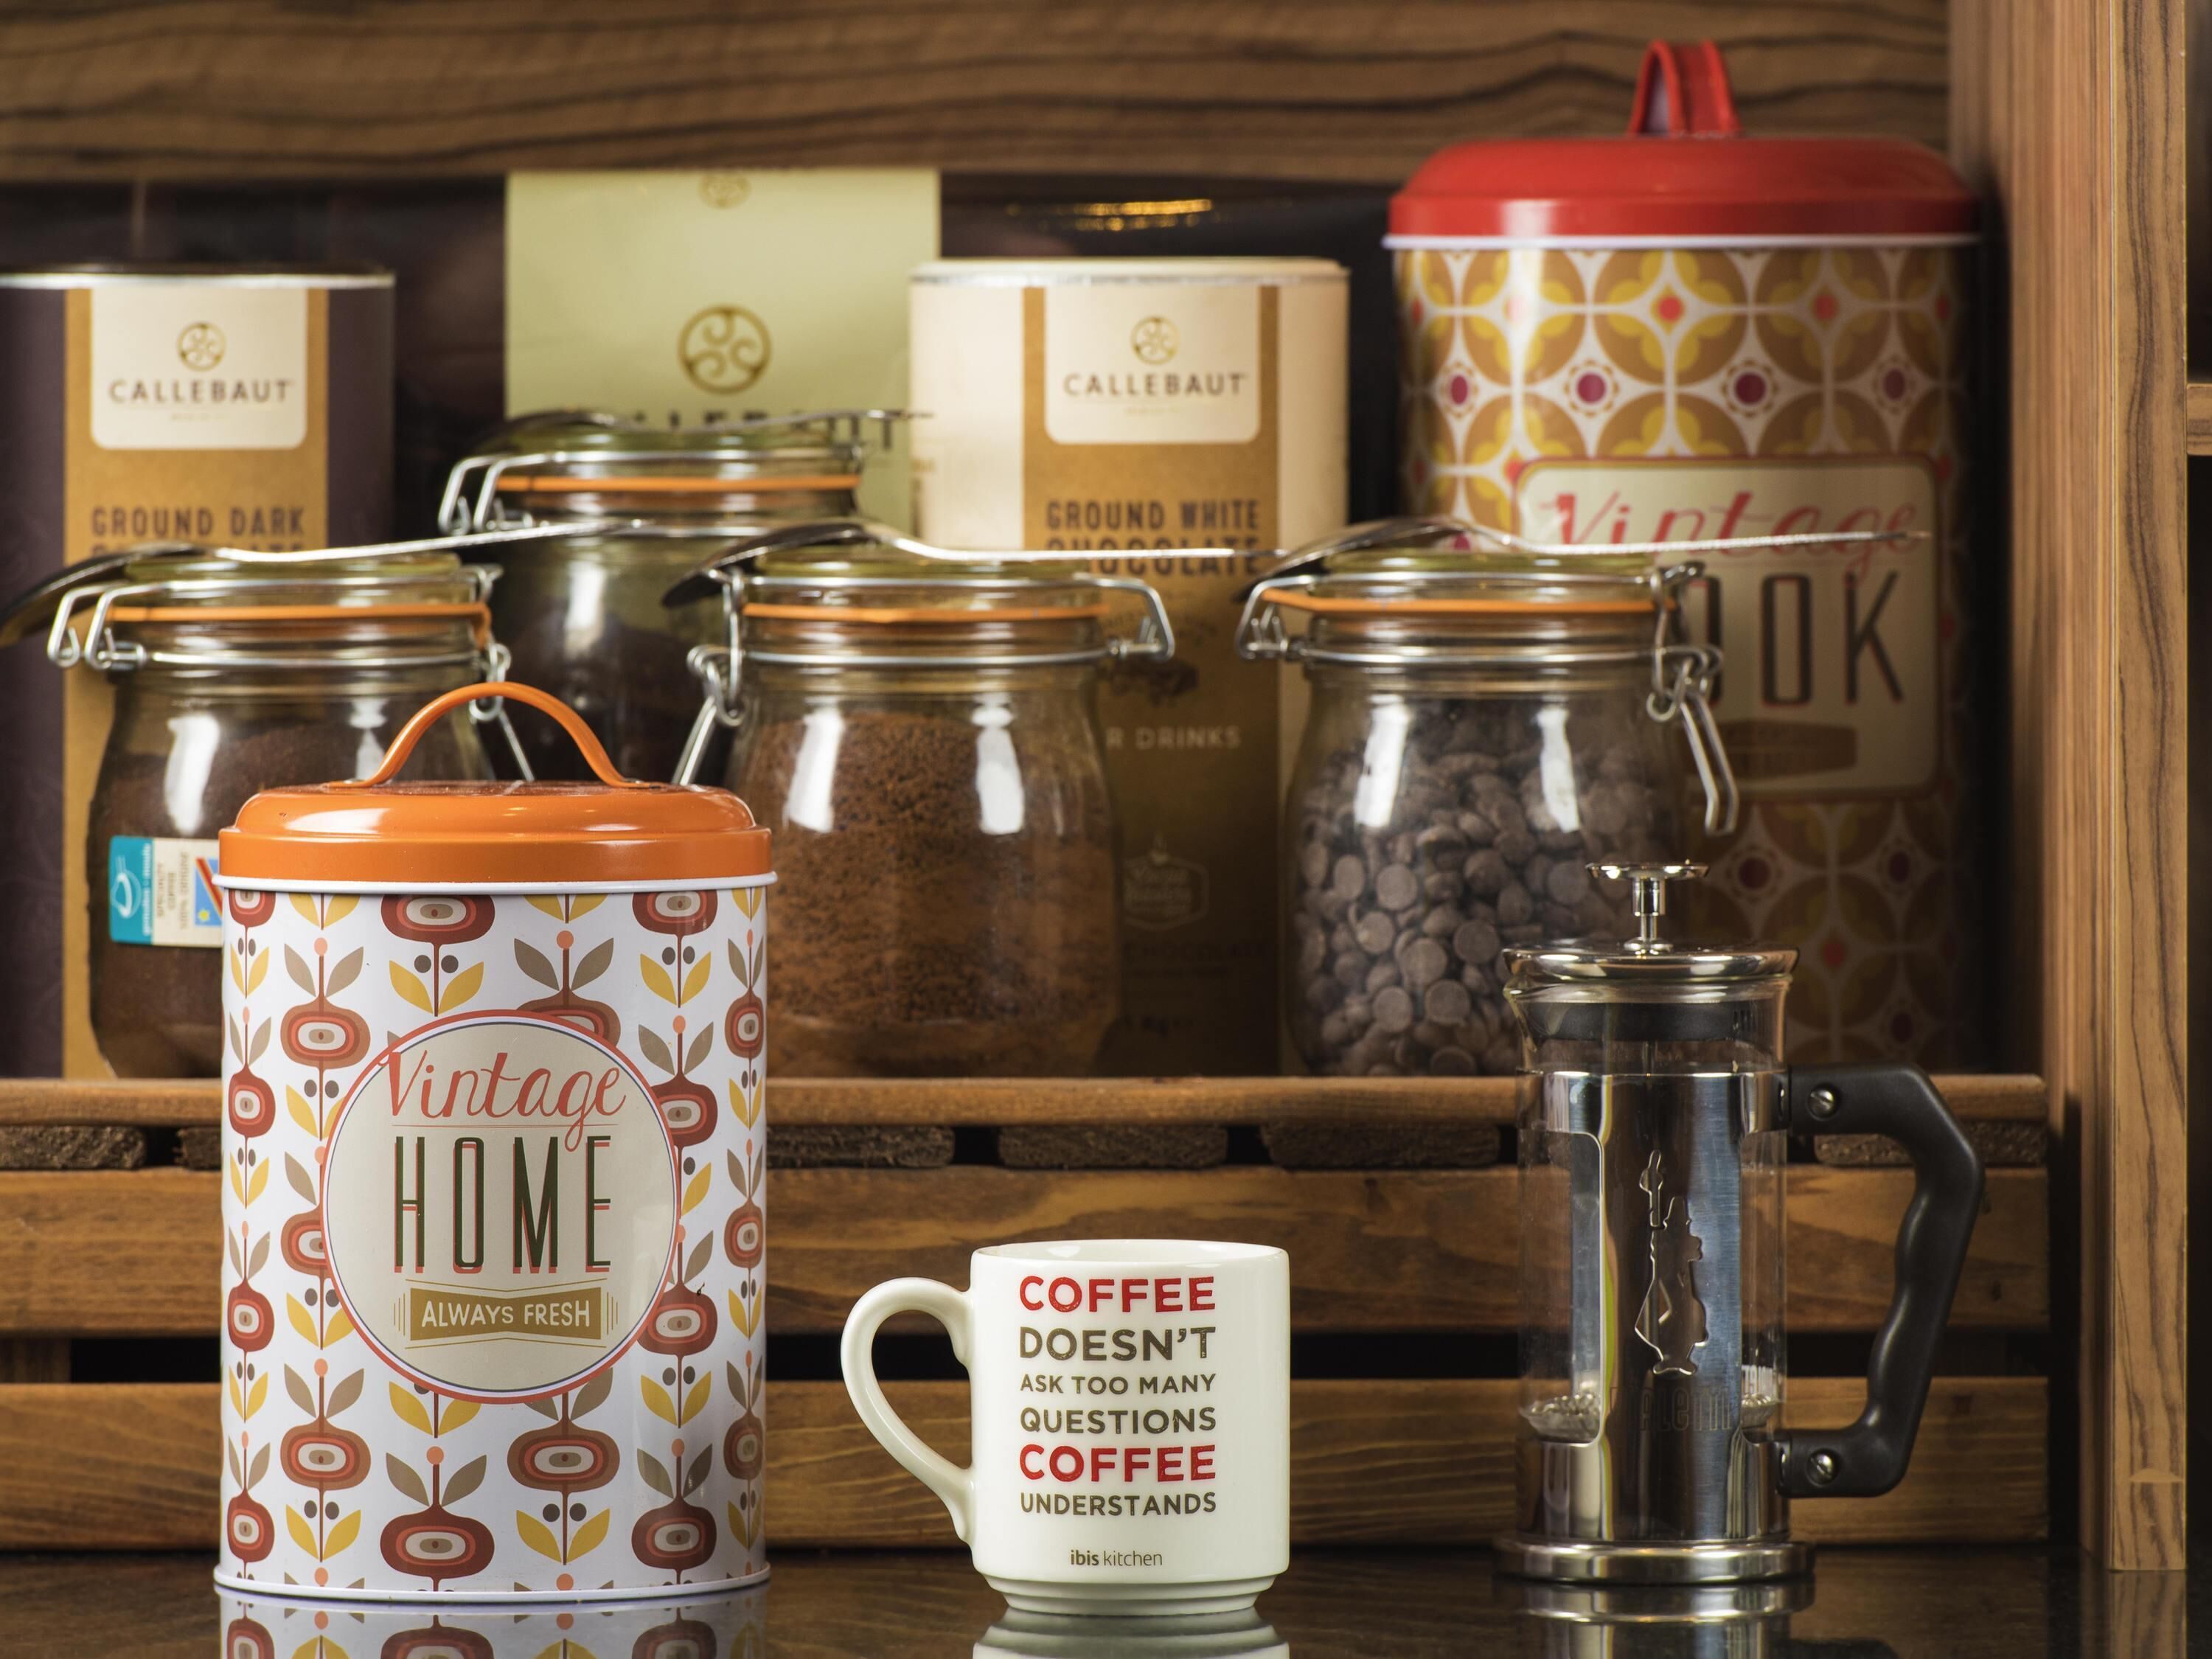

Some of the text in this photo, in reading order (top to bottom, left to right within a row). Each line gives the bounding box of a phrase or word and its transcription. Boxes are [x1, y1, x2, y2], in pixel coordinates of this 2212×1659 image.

[108, 378, 290, 403] CALLEBAUT
[1062, 372, 1244, 396] CALLEBAUT
[91, 506, 306, 538] GROUND DARK
[1046, 498, 1260, 532] GROUND WHITE
[1135, 726, 1242, 751] DRINKS
[377, 1049, 626, 1152] Vintage
[394, 1135, 611, 1273] HOME
[1020, 1276, 1216, 1313] COFFEE
[422, 1300, 589, 1327] ALWAYS FRESH
[1020, 1326, 1217, 1362] DOESN'T
[1020, 1374, 1217, 1395] ASK TOO MANY
[1020, 1407, 1217, 1435] QUESTIONS
[1020, 1444, 1216, 1483] COFFEE
[1020, 1492, 1217, 1517] UNDERSTANDS
[1071, 1550, 1163, 1567] ibis kitchen
